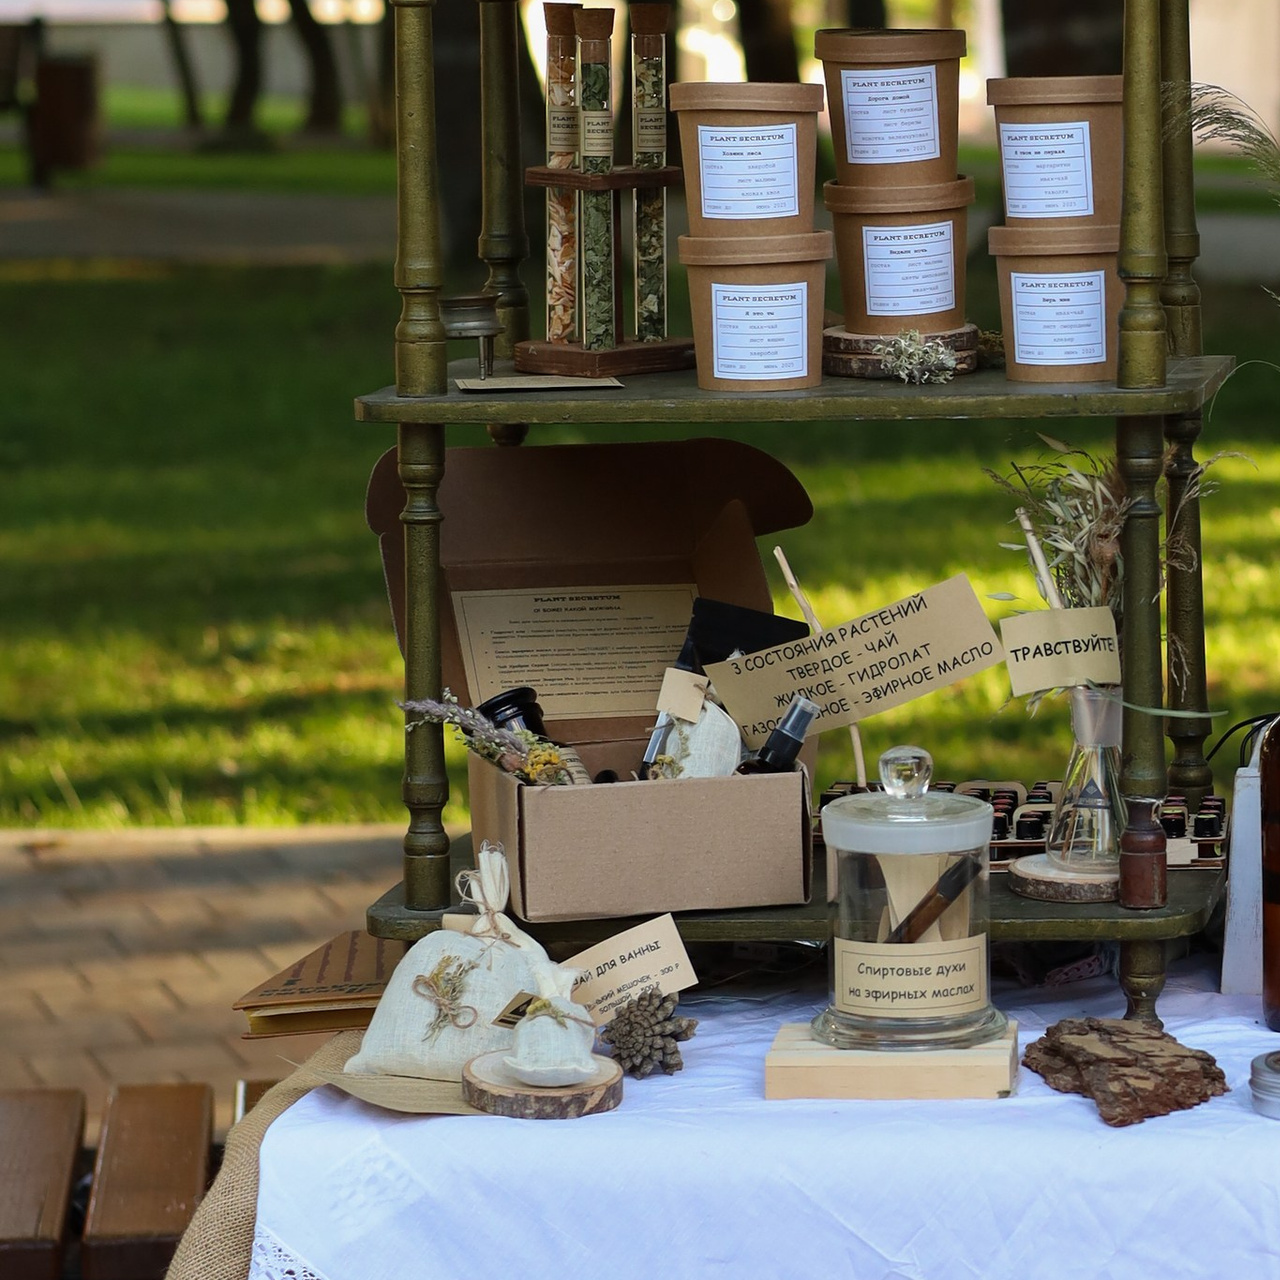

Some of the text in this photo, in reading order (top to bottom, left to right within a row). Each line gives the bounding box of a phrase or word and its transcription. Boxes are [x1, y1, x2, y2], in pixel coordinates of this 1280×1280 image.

[731, 594, 928, 675] 3 СОСТОЯНИЯ РАСТЕНИЙ
[1010, 634, 1116, 664] ТРАВСТВУЙТЕ
[786, 630, 899, 681] ТВЕРДОЕ ЧАЙ
[742, 641, 993, 737] ГАЗОНОЕ ЭФИРНОЕ МАСЛО
[774, 643, 932, 708] ЖИДКОЕ ГИДРОЛАТ
[596, 960, 617, 977] ДЛЯ
[620, 941, 661, 964] ВАННЫ
[857, 961, 967, 980] Спиртовые духи
[617, 965, 673, 993] МЕШОЧЕК 300
[848, 982, 975, 1003] на эфирных маслах
[599, 993, 632, 1014] БОЛЬШОЙ
